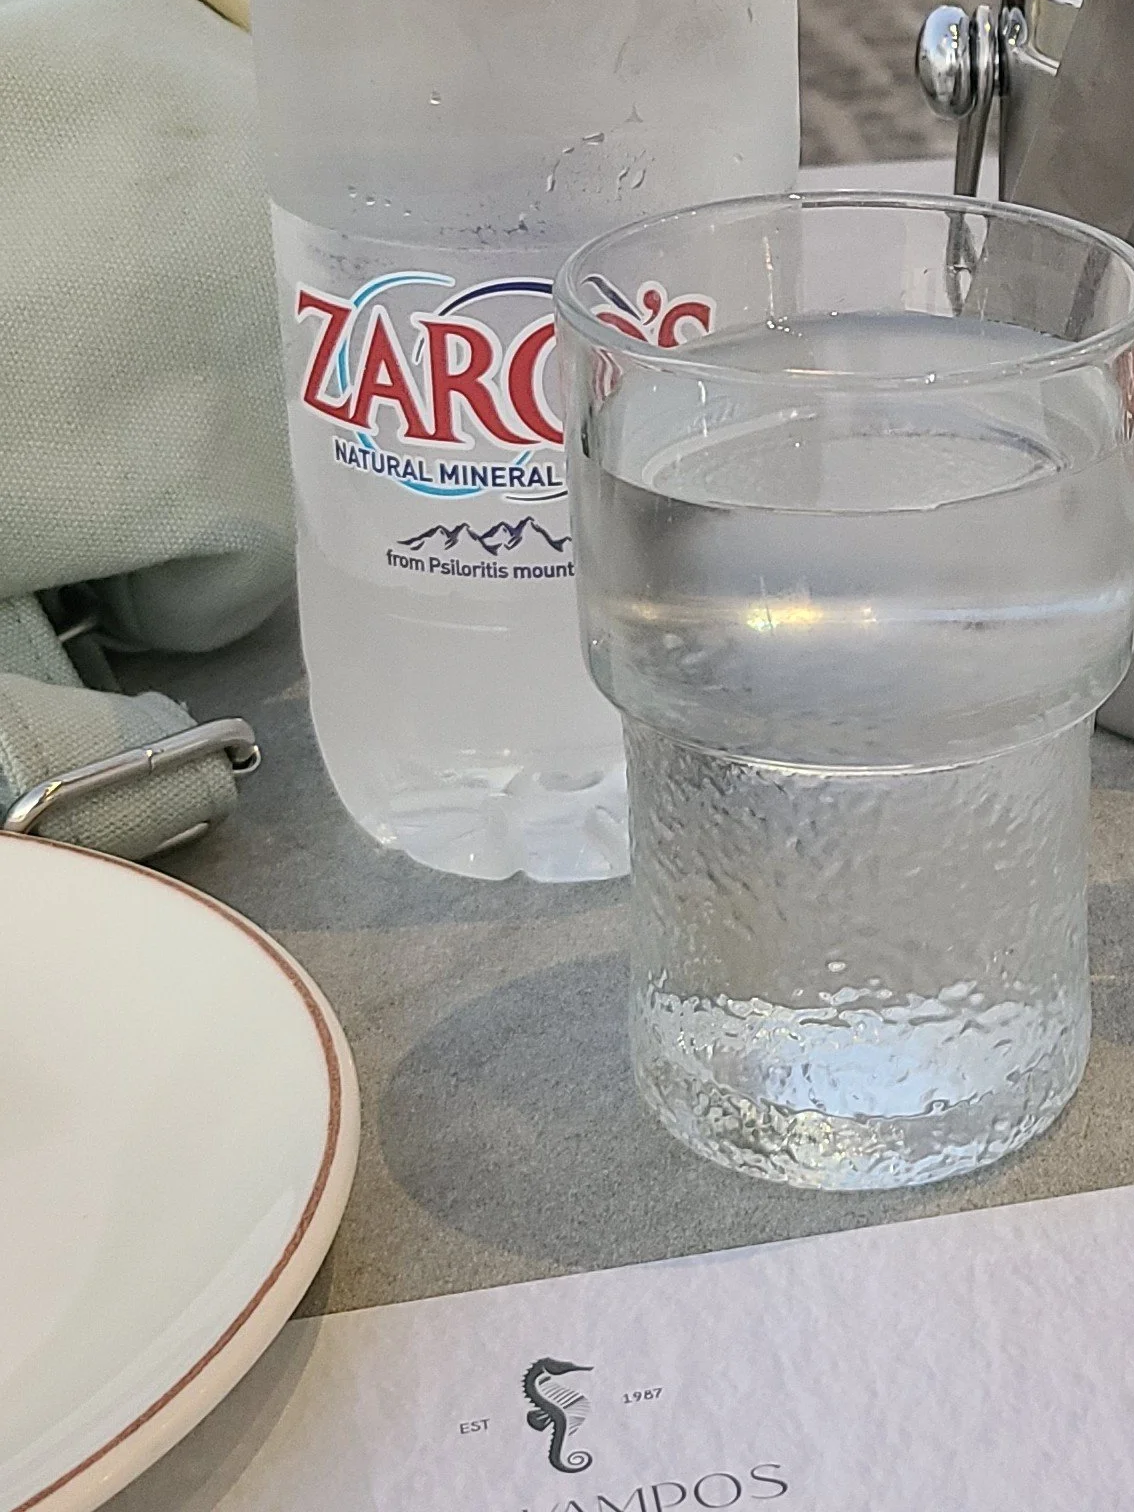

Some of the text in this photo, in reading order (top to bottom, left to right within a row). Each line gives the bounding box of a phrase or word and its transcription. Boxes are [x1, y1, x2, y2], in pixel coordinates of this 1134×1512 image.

[334, 438, 563, 487] NATURAL MINERAL
[387, 549, 425, 574] from
[429, 556, 509, 579] Psiloritis
[622, 1387, 663, 1404] 1987
[459, 1418, 491, 1434] EST
